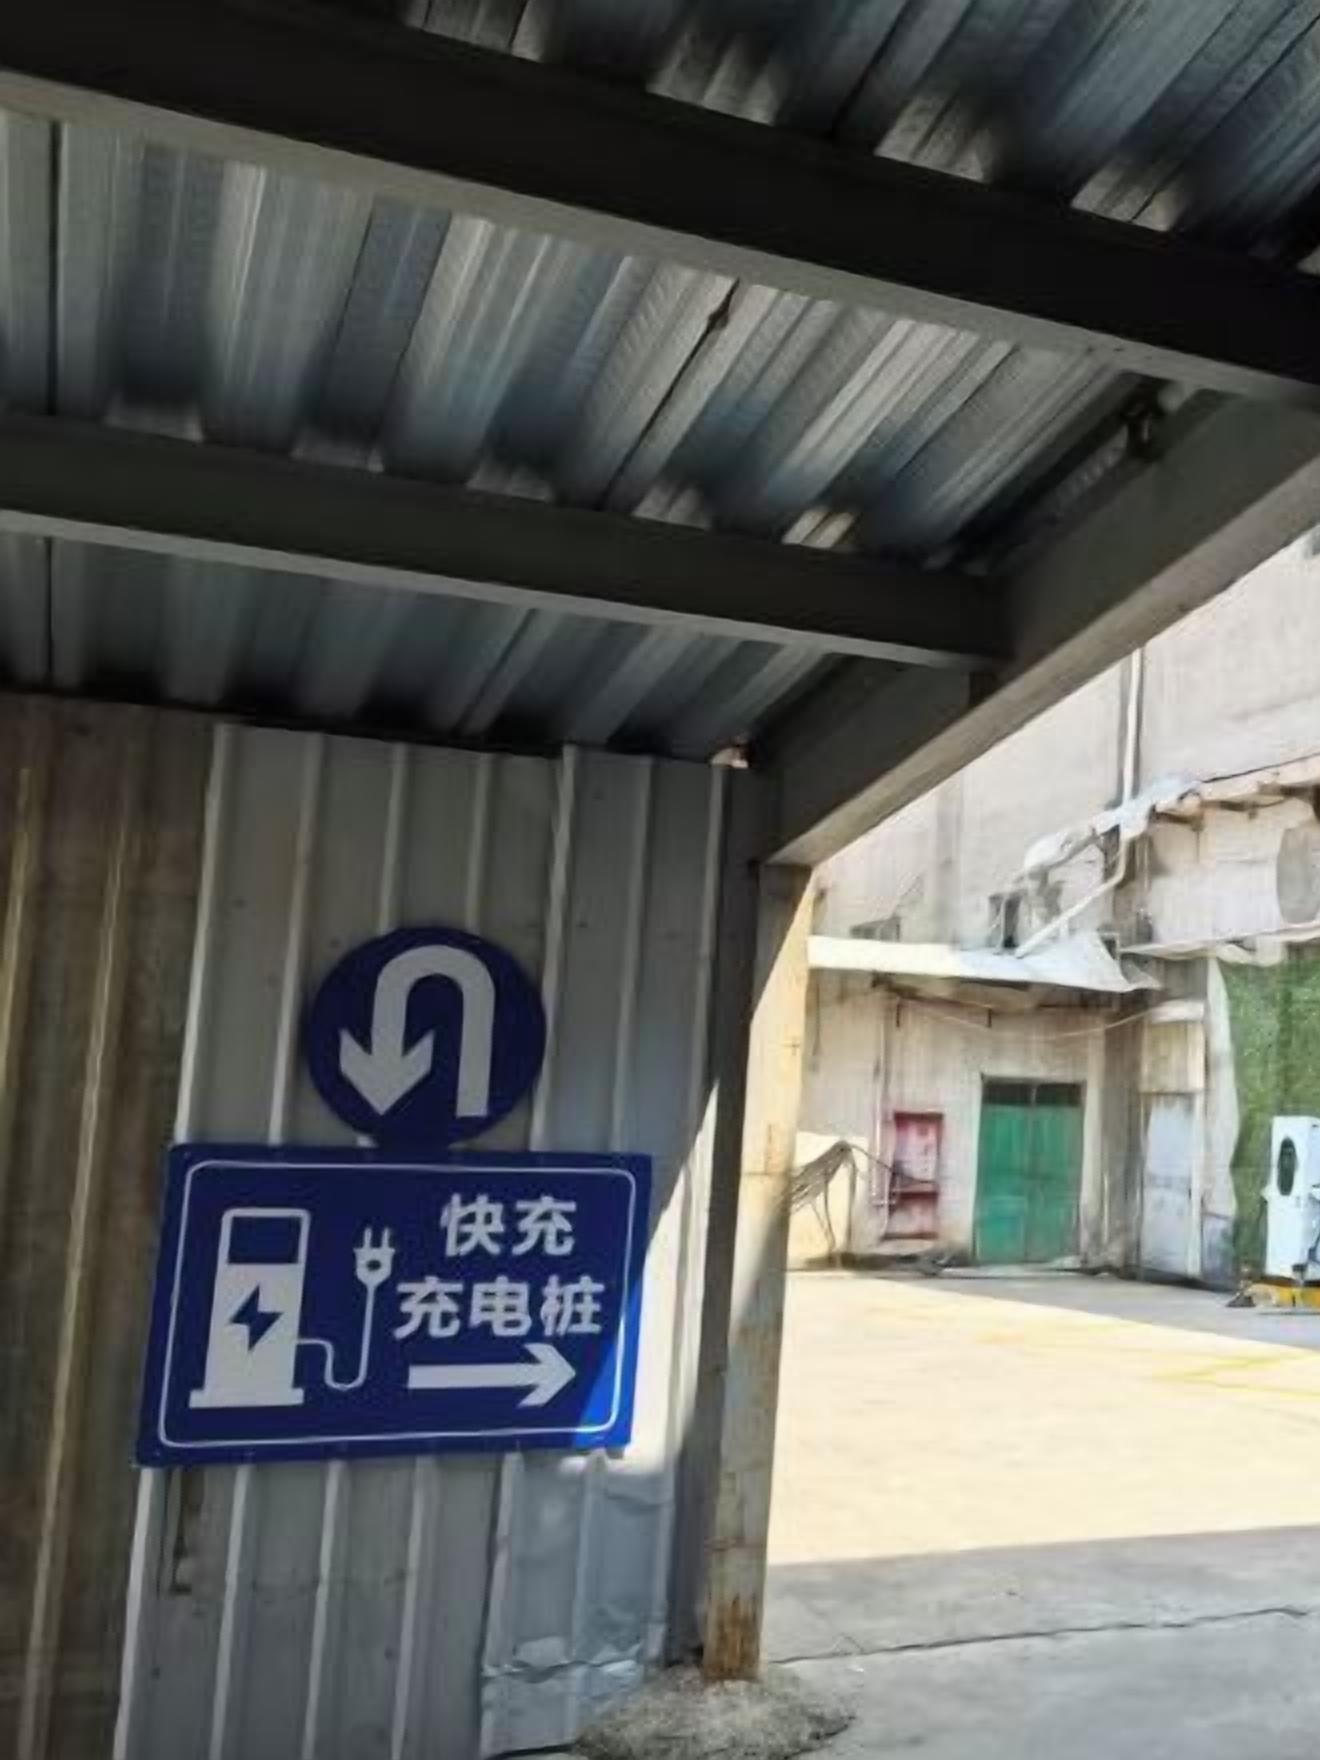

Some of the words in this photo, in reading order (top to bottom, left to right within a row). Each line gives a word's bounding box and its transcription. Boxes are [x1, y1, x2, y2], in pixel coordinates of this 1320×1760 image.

[440, 1193, 576, 1256] 快充
[394, 1274, 604, 1339] 充电桩
